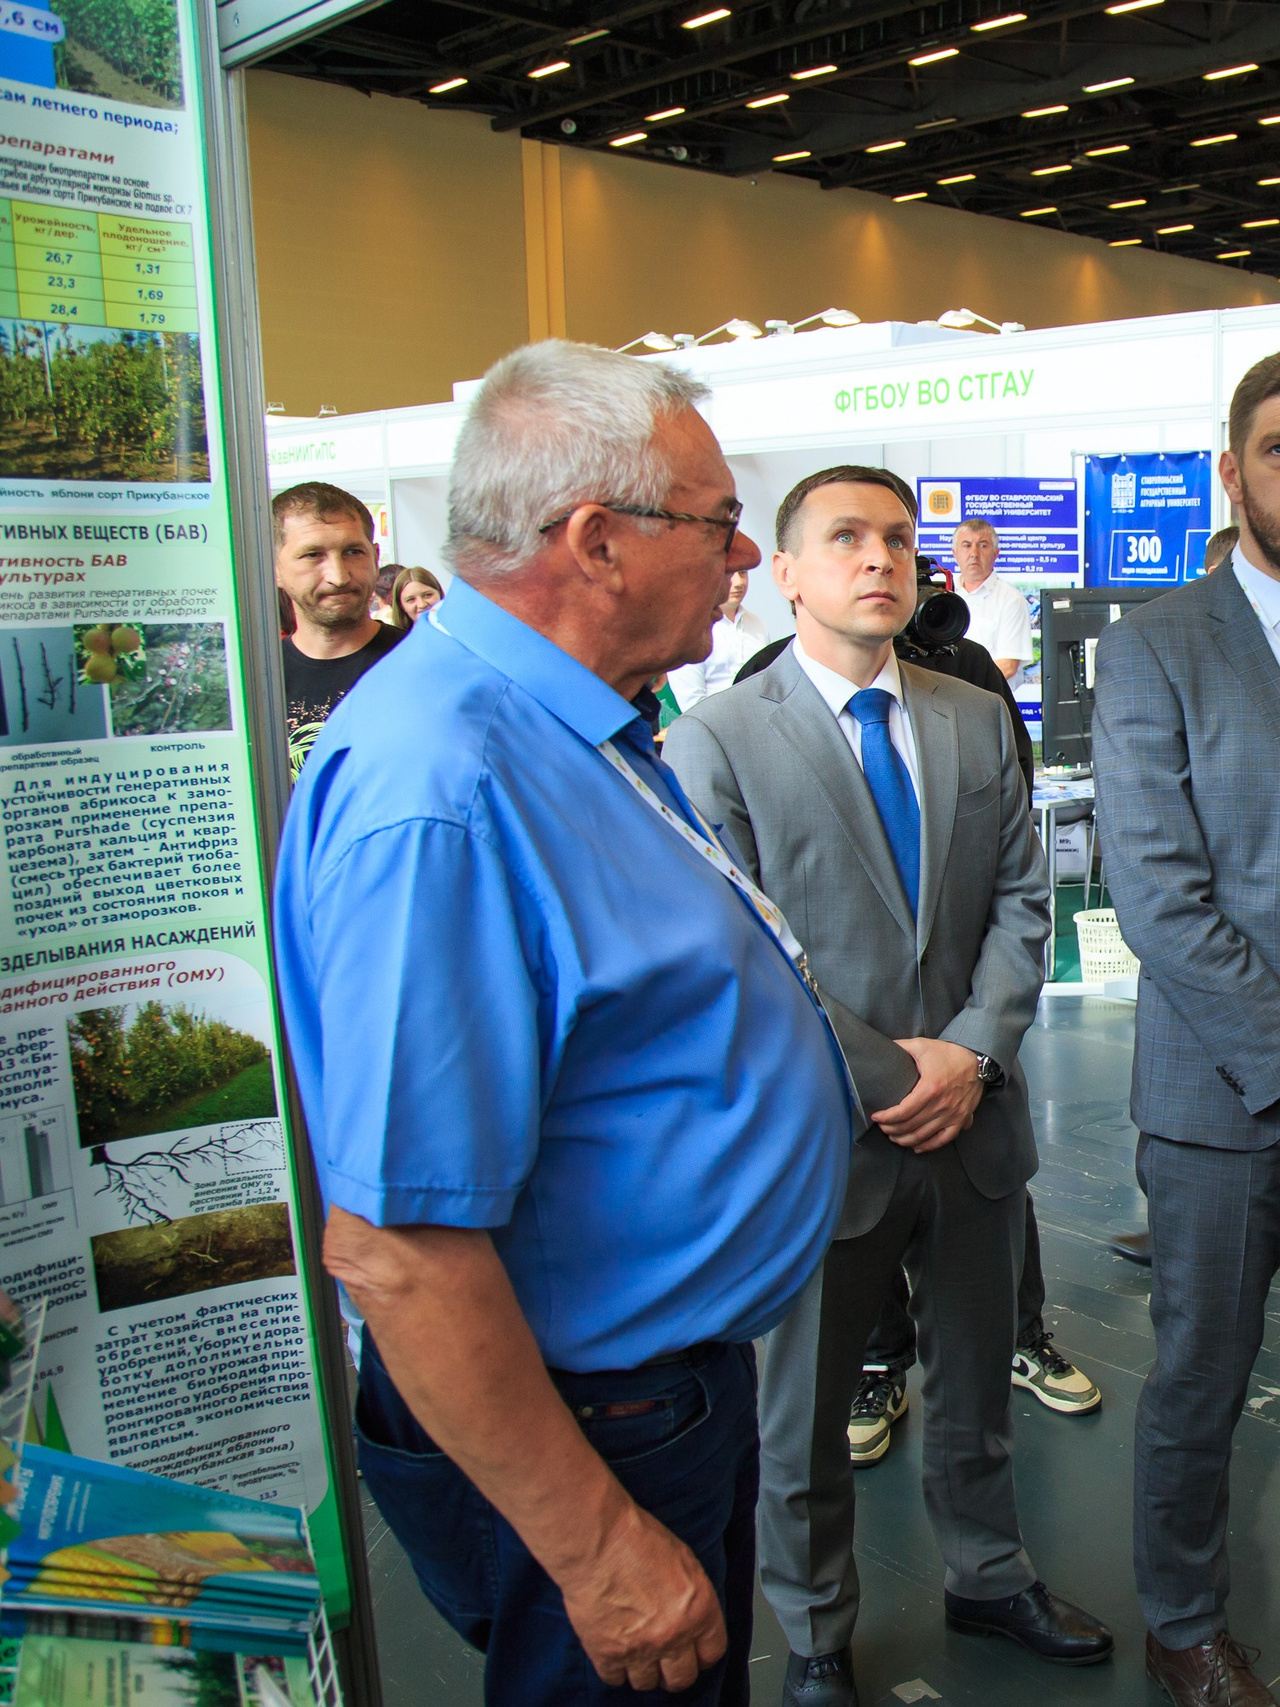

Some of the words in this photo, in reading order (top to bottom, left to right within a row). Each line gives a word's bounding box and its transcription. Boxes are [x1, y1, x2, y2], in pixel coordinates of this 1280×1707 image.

[33, 19, 59, 34] см
[32, 96, 98, 118] летнего
[104, 111, 178, 135] периода;
[123, 178, 150, 189] основе
[134, 188, 161, 201] Glomus
[53, 190, 75, 201] сорта
[146, 203, 173, 214] подвое
[45, 252, 73, 266] 26,7
[136, 263, 160, 275] 1,31
[48, 276, 75, 290] 23,3
[137, 289, 163, 300] 1,69
[50, 303, 77, 317] 28,4
[139, 313, 165, 324] 1,79
[835, 382, 909, 412] ФГБОУ
[918, 378, 950, 405] ВО
[959, 369, 1034, 401] СТГАУ
[51, 488, 94, 499] яблони
[97, 491, 123, 501] сорт
[127, 490, 210, 502] Прикубанское
[965, 501, 1033, 509] ГОСУДАРСТВЕННЫЙ
[73, 525, 149, 543] ВЕЩЕСТВ
[156, 523, 208, 544] (БАВ)
[91, 554, 128, 567] БАВ
[1127, 536, 1162, 563] 300
[29, 590, 86, 602] развития
[90, 588, 178, 598] генеративных
[182, 588, 218, 597] почек
[52, 599, 129, 609] зависимости
[150, 597, 215, 608] обработок
[74, 608, 129, 619] Purshade
[145, 607, 207, 617] Антифриз
[150, 743, 206, 753] контроль
[1, 784, 111, 809] устойчивости
[115, 775, 231, 794] генеративных
[14, 778, 52, 794] Для
[65, 762, 230, 786] индуцирования
[2, 803, 70, 821] органов
[79, 793, 157, 812] абрикоса
[187, 787, 232, 799] замо-
[4, 818, 63, 835] розкам
[71, 804, 171, 825] применение
[180, 801, 234, 814] препа-
[6, 834, 44, 849] рата
[54, 821, 131, 840] Purshade
[141, 812, 235, 831] (суспензия
[7, 841, 92, 860] карбоната
[99, 831, 167, 846] кальция
[193, 825, 236, 838] квар-
[88, 847, 134, 862] затем
[159, 837, 238, 854] Антифриз
[11, 870, 65, 888] (смесь
[69, 864, 104, 879] трех
[108, 852, 184, 871] бактерий
[187, 848, 240, 862] тиоба-
[12, 883, 53, 900] цил)
[62, 867, 181, 891] обеспечивает
[192, 861, 242, 874] более
[13, 892, 83, 913] поздний
[92, 883, 146, 900] выход
[155, 874, 243, 892] цветковых
[15, 910, 64, 926] почек
[92, 893, 176, 912] состояния
[182, 887, 230, 901] покоя
[17, 919, 78, 939] «уход»
[101, 903, 202, 924] заморозков.
[0, 938, 126, 973] ЗДЕЛЫВАНИЯ
[132, 920, 256, 950] НАСАЖДЕНИЙ
[0, 960, 176, 1000] дифицированного
[74, 975, 161, 1002] действия
[167, 966, 225, 988] (ОМУ)
[17, 1028, 54, 1041] пре-
[194, 1181, 217, 1190] Зона
[241, 1180, 261, 1189] ОМУ
[245, 1195, 277, 1205] дерева
[128, 1312, 186, 1334] учетом
[195, 1290, 298, 1320] фактических
[95, 1332, 148, 1353] затрат
[155, 1312, 235, 1339] хозяйства
[266, 1302, 299, 1318] при-
[96, 1335, 205, 1364] обретение,
[215, 1314, 301, 1337] внесение
[97, 1349, 192, 1379] удобрений,
[194, 1333, 249, 1355] уборку
[263, 1325, 305, 1340] дора-
[99, 1367, 154, 1389] ботку
[164, 1335, 304, 1375] дополнительно
[101, 1366, 207, 1400] полученного
[209, 1352, 268, 1375] урожая
[270, 1347, 304, 1363] при-
[102, 1385, 177, 1411] менение
[187, 1360, 307, 1391] биомодифици-
[105, 1394, 191, 1425] рованного
[193, 1375, 276, 1405] удобрения
[278, 1370, 312, 1387] про-
[106, 1394, 237, 1436] лонгированного
[240, 1382, 310, 1403] действия
[108, 1420, 186, 1448] является
[196, 1392, 311, 1425] экономически
[110, 1430, 199, 1459] выгодным.
[226, 1436, 275, 1454] яблони
[258, 1440, 295, 1456] зона)
[260, 1490, 278, 1500] 13,3
